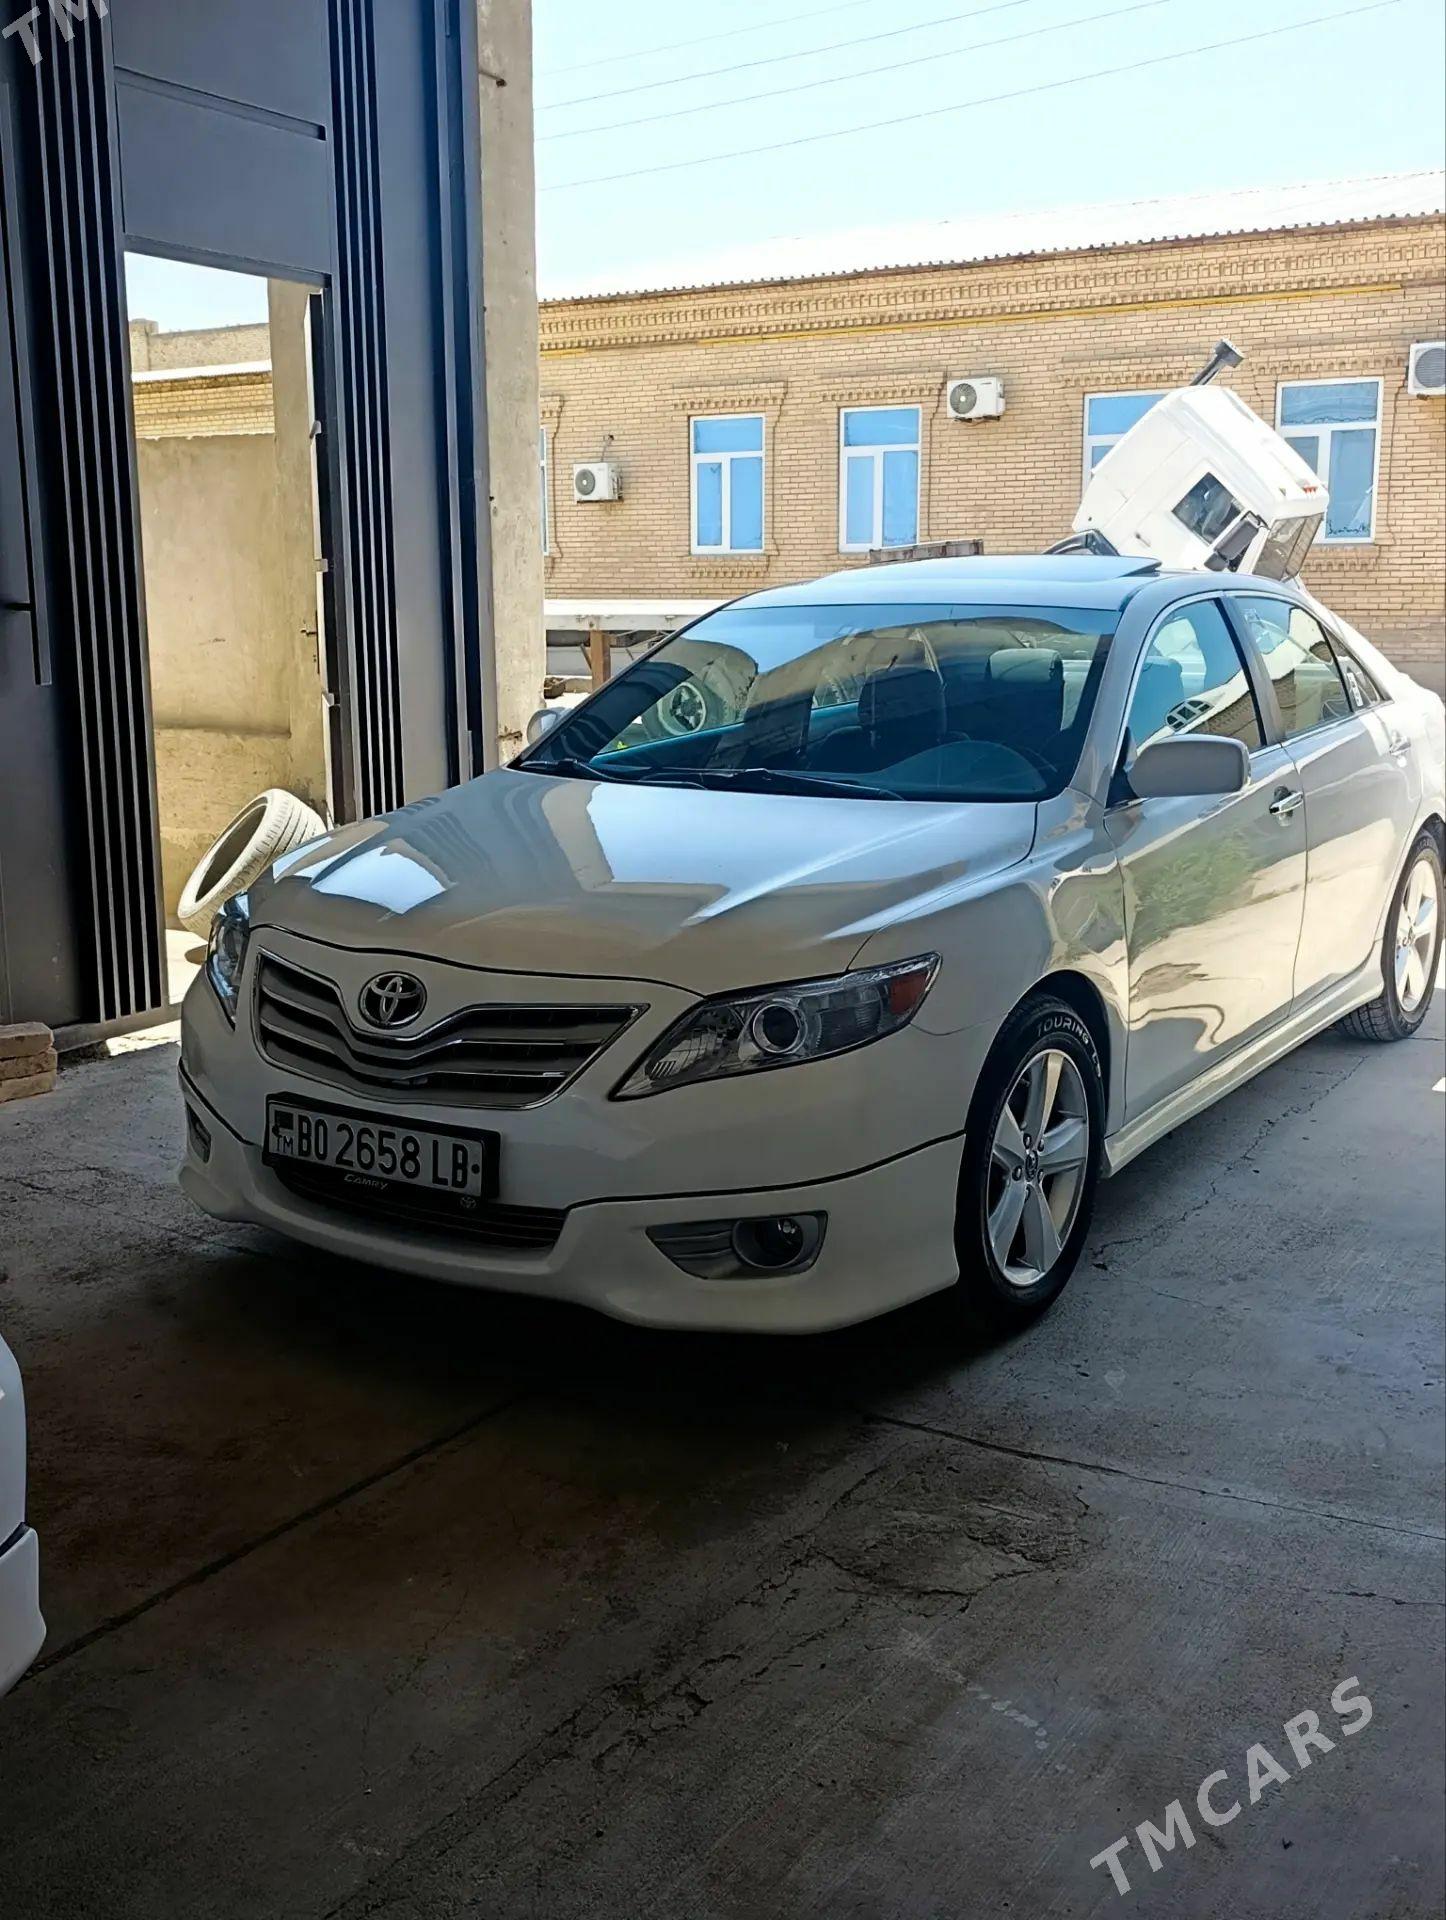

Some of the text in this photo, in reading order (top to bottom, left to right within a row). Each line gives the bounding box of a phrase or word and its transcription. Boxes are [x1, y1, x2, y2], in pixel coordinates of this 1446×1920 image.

[1037, 1016, 1089, 1044] TOURING
[335, 1123, 421, 1179] 2658
[432, 1139, 468, 1188] LB
[344, 1173, 389, 1190] CAMRY
